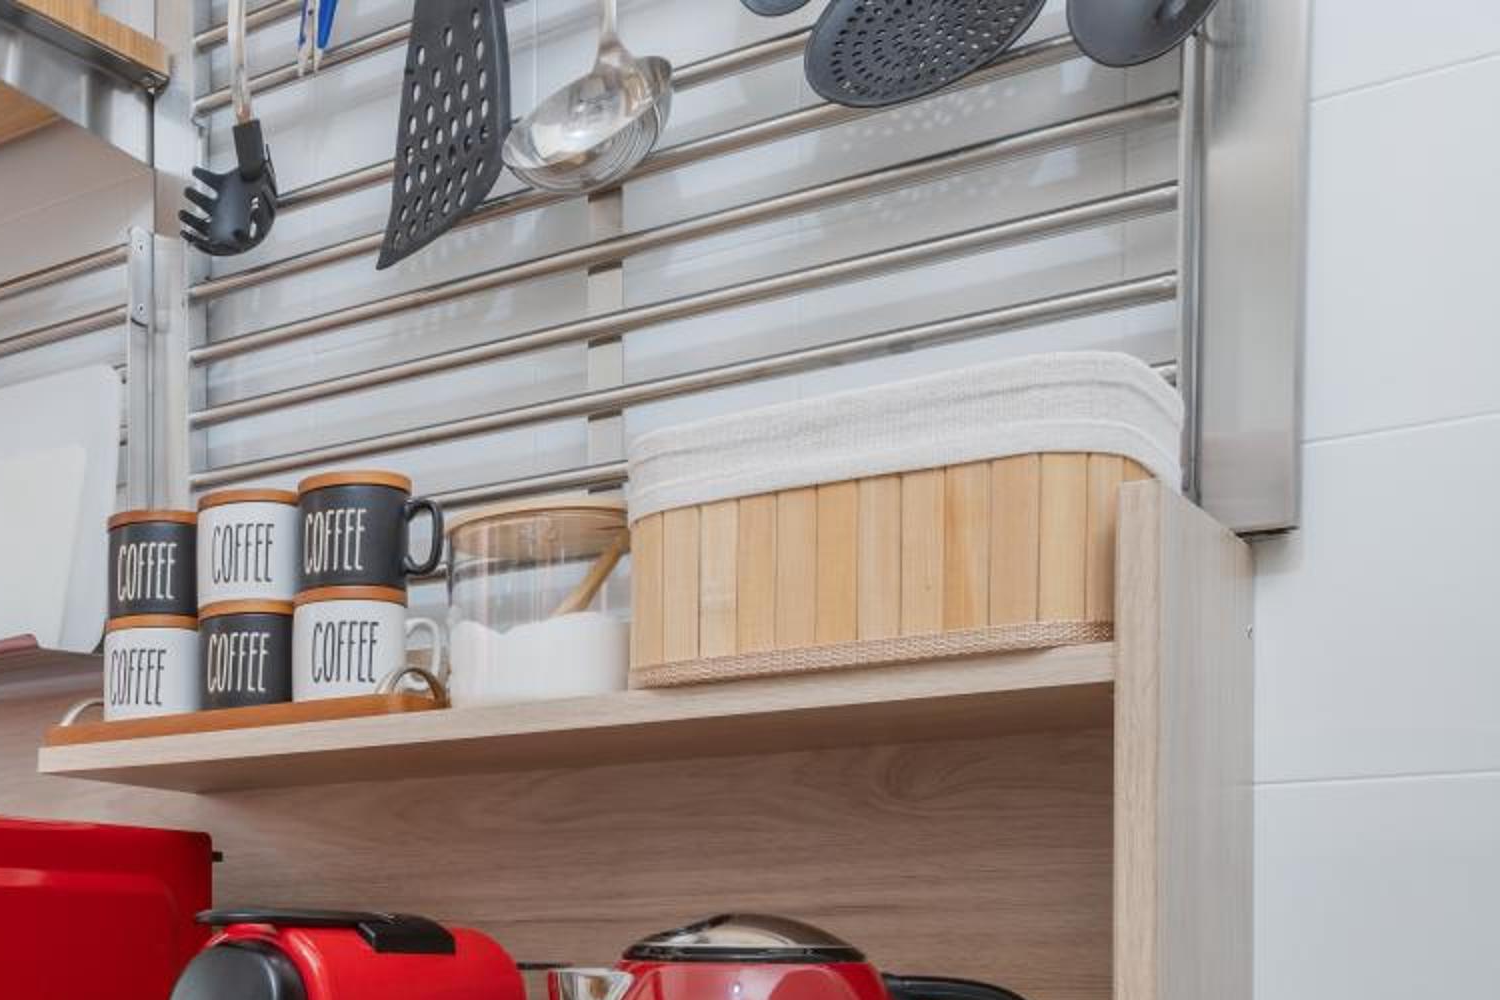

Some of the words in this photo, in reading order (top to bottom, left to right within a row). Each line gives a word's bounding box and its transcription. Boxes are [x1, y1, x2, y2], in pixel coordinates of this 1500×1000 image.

[117, 541, 177, 602] COFFEE
[212, 523, 275, 585] COFFEE
[303, 508, 368, 575] COFFEE
[110, 649, 167, 706] COFFEE
[207, 631, 271, 694] COFFEE
[312, 620, 380, 684] COFFEE
